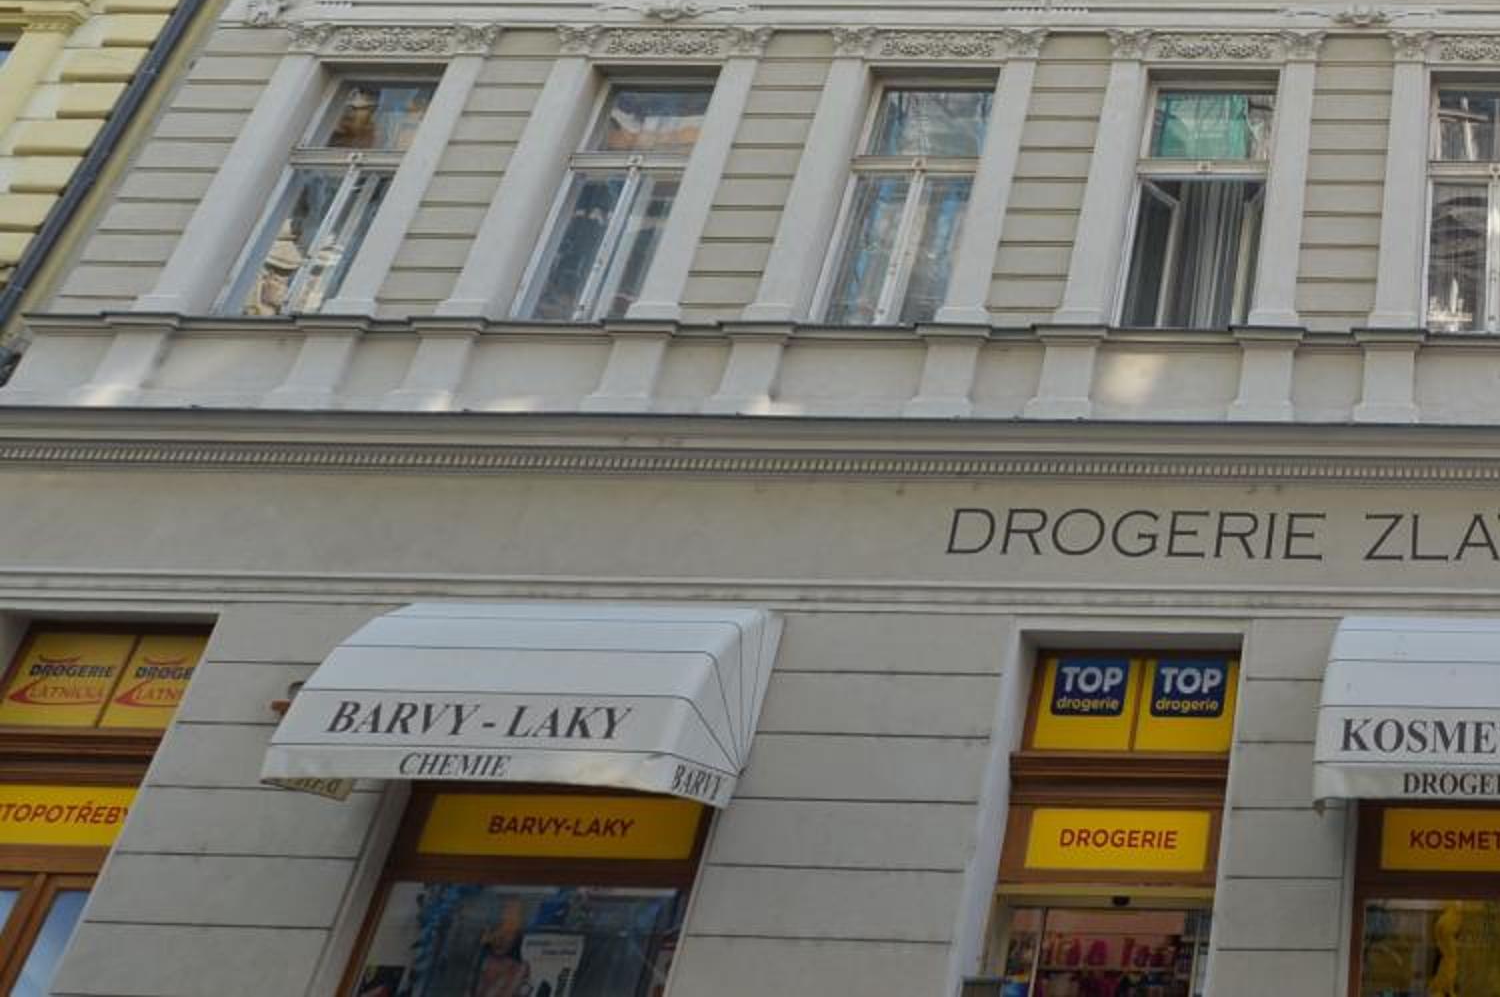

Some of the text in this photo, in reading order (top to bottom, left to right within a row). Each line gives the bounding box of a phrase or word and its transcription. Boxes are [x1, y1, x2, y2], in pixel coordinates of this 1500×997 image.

[944, 507, 1327, 561] DROGERIE
[29, 663, 115, 679] DROGERIE
[1061, 666, 1124, 693] TOP
[1160, 667, 1223, 694] TOP
[1056, 696, 1120, 712] drogerie
[1155, 697, 1219, 713] drogerie
[324, 701, 481, 736] BARVY
[503, 705, 633, 739] LAKY
[399, 752, 511, 777] CHEMIE
[487, 814, 636, 838] BARVY-LAKY
[1059, 828, 1179, 850] DROGERIE
